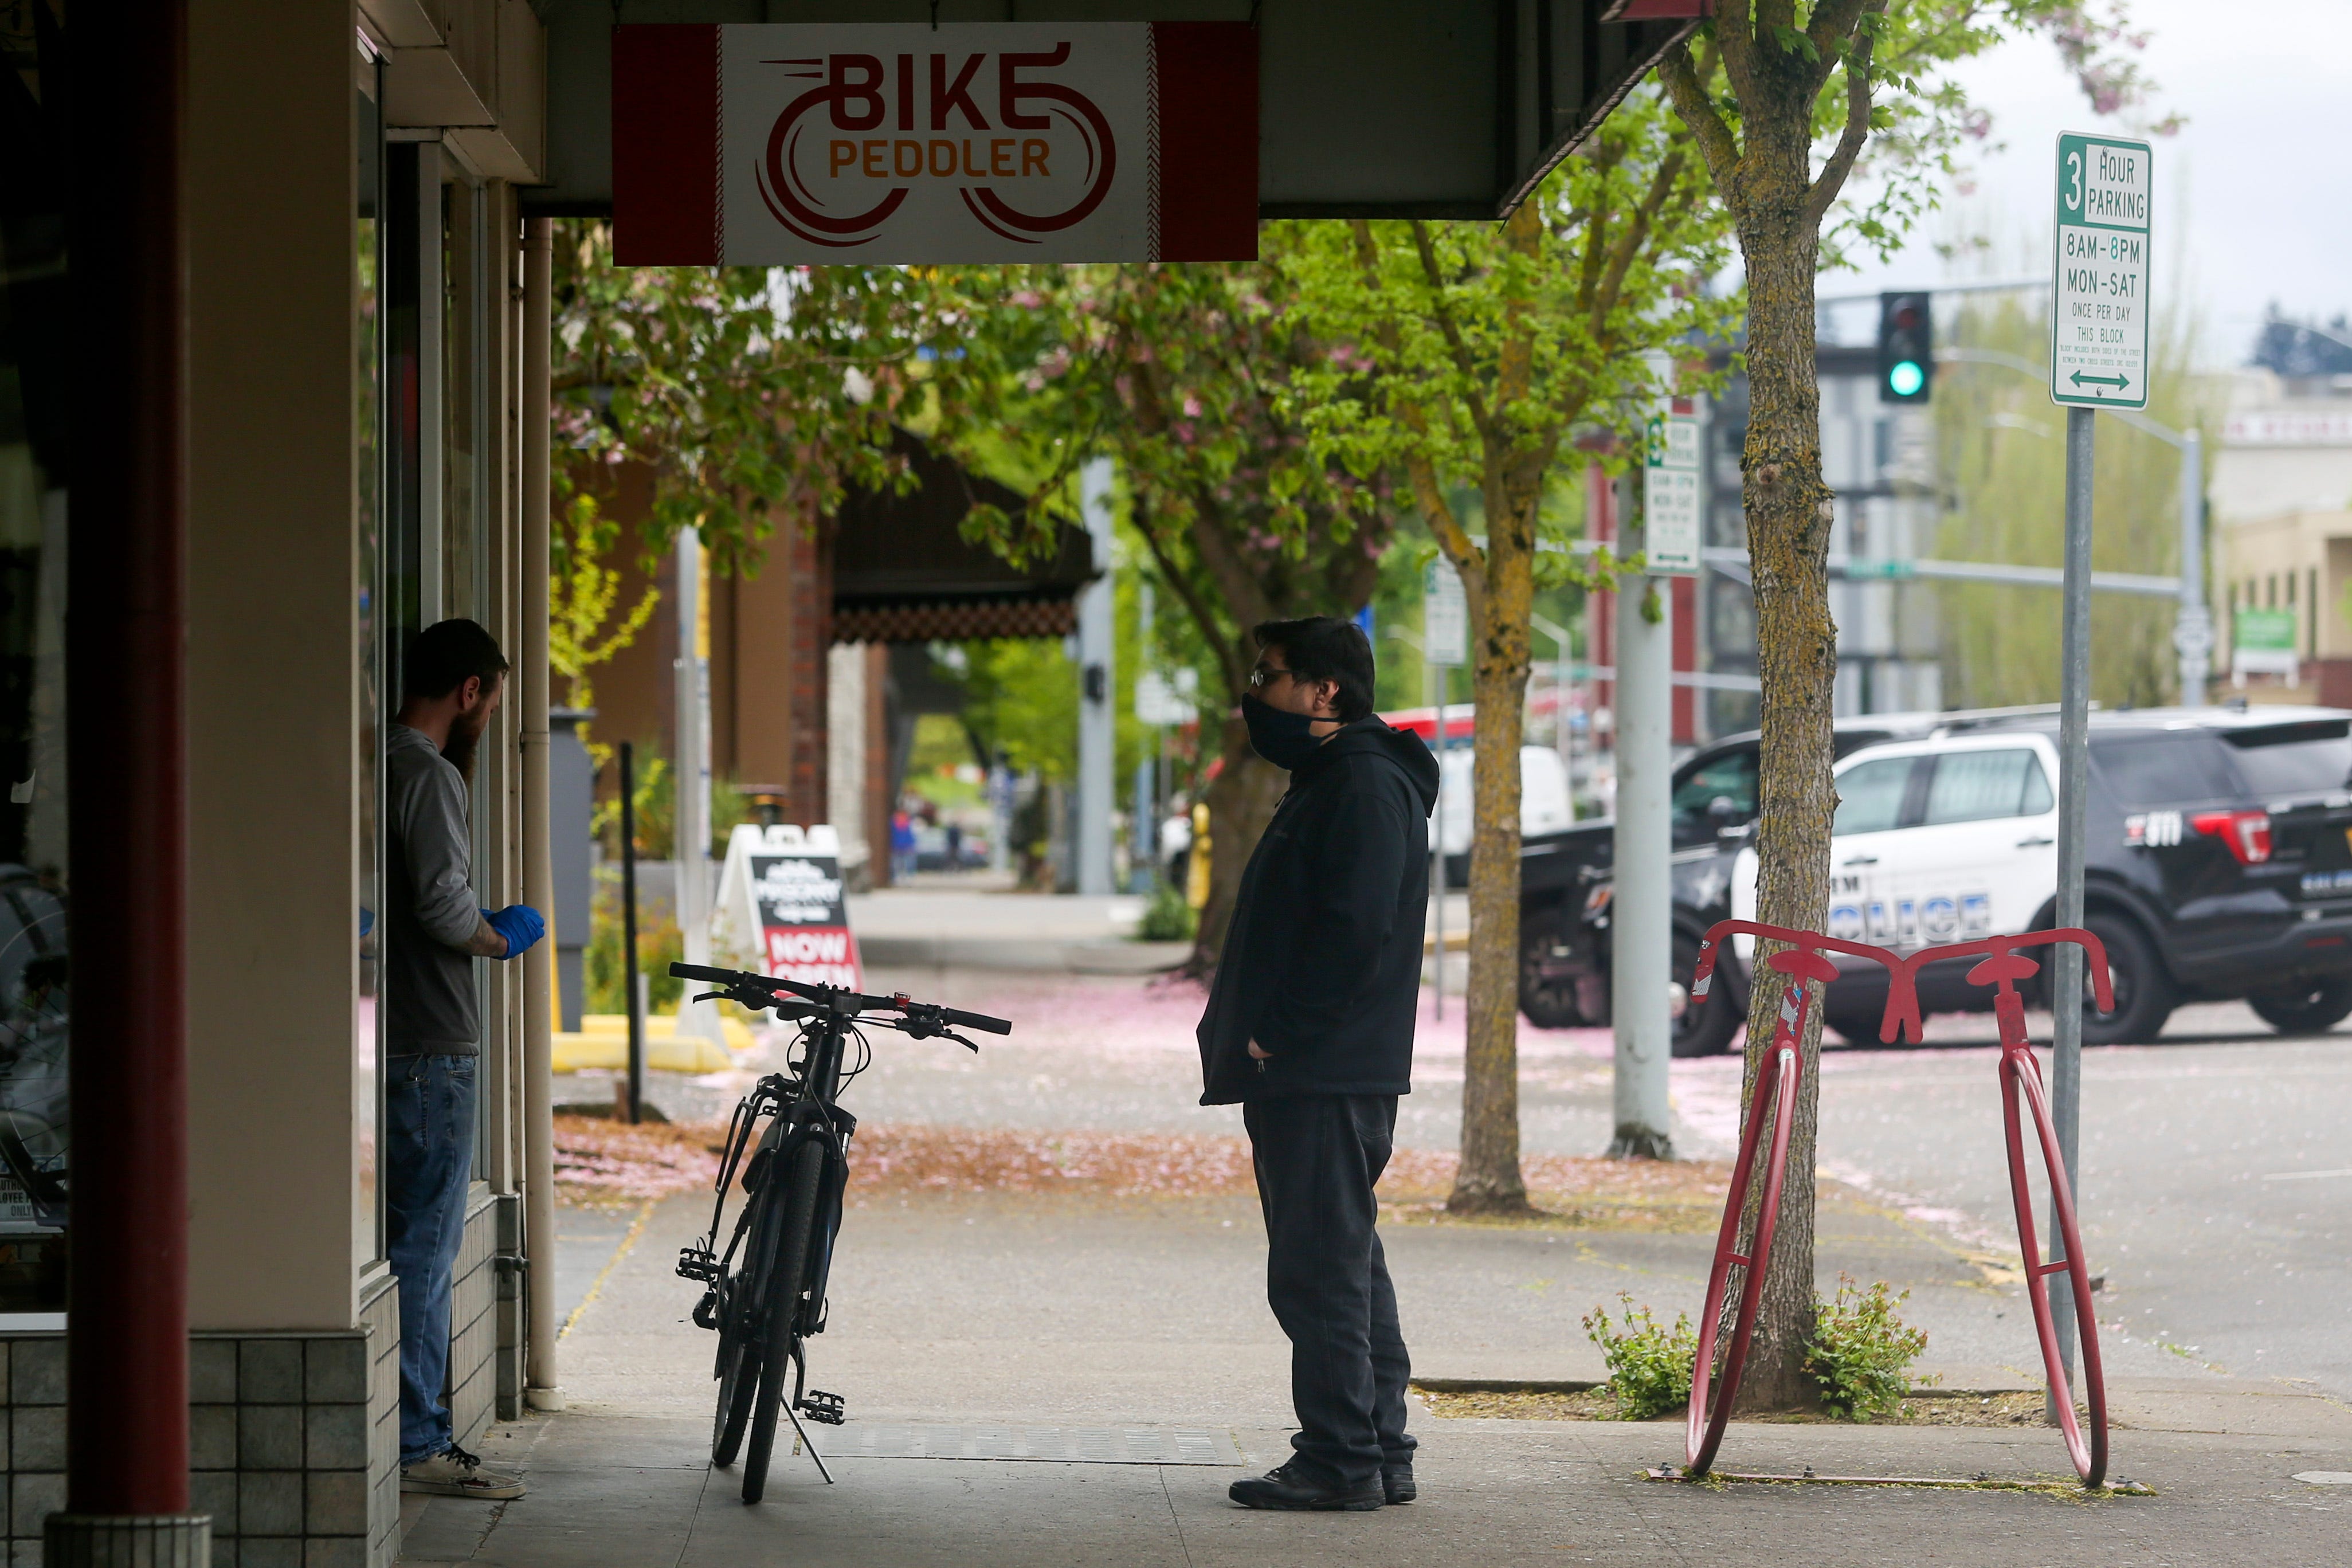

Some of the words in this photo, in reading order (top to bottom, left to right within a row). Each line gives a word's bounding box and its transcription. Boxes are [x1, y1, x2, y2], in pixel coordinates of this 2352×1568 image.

[829, 42, 1071, 131] BIKE
[830, 139, 1050, 178] PEDDLER
[2100, 155, 2134, 184] HOUR
[2065, 151, 2081, 211] 3
[2089, 188, 2144, 219] PARKING
[2072, 302, 2091, 318] ONCE
[2097, 304, 2111, 320] PER
[2116, 306, 2130, 322] DAY
[2077, 326, 2094, 342] THIS
[2100, 328, 2124, 343] BLOCK
[1829, 894, 1989, 946] OLICE
[770, 932, 848, 963] NOW
[11, 1205, 31, 1216] ONLY
